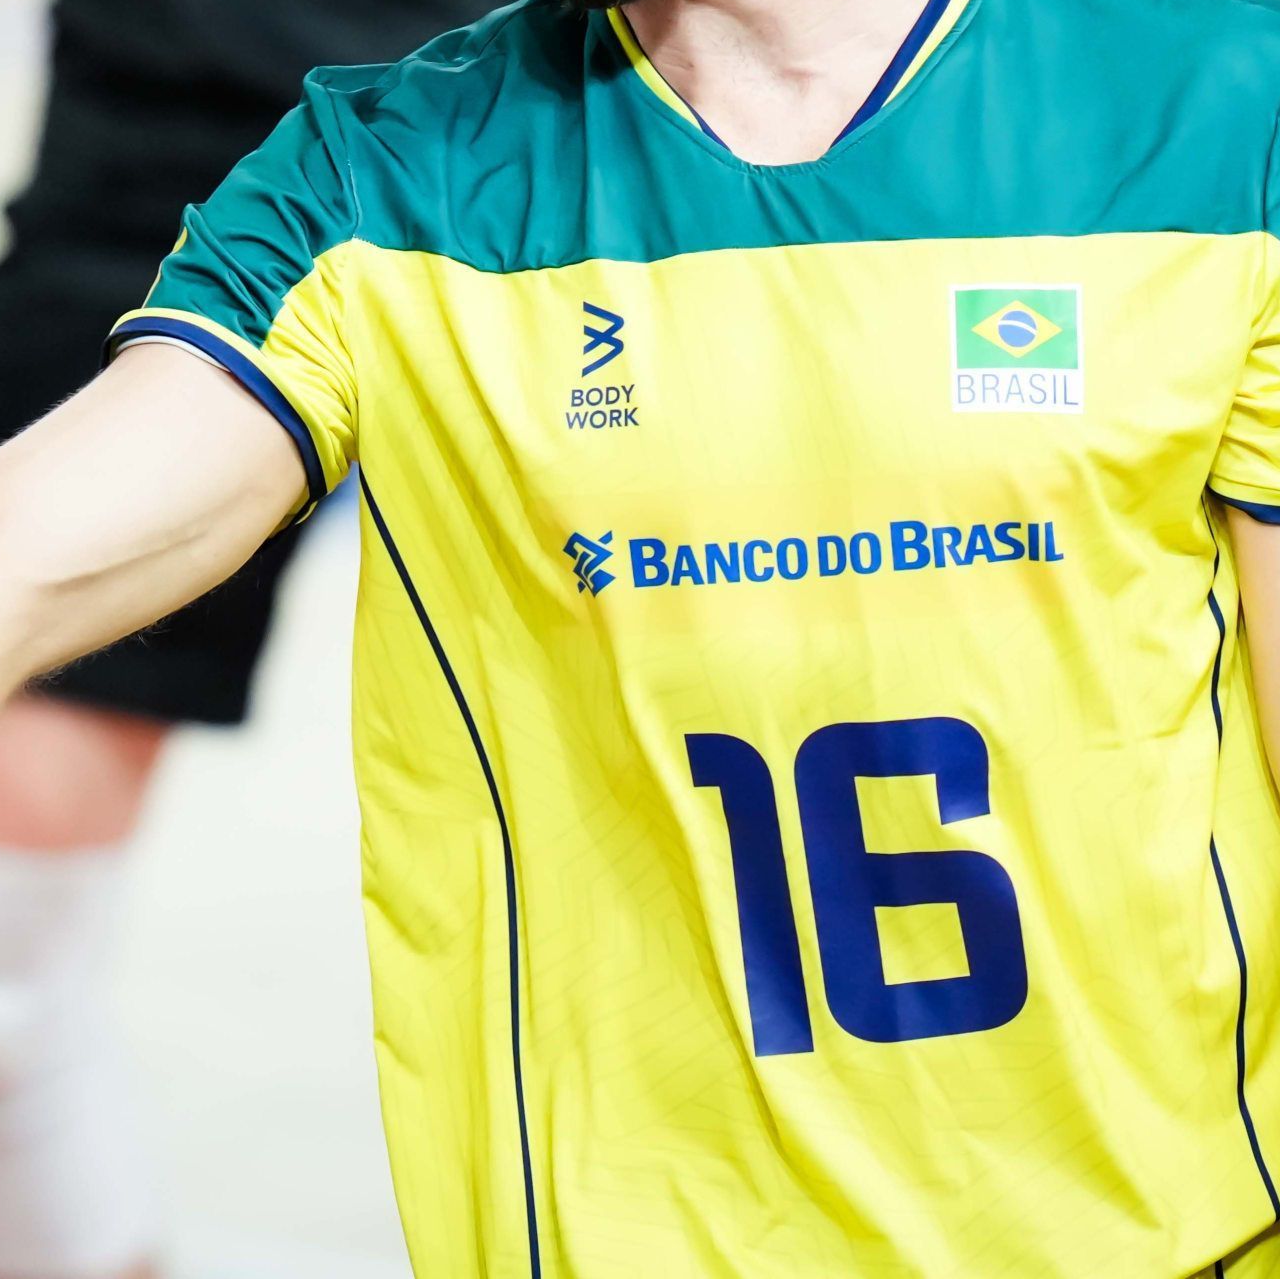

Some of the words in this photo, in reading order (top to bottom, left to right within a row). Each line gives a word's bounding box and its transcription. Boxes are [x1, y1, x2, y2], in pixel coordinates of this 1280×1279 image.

[570, 384, 635, 407] BODY
[956, 374, 1080, 407] BRASIL
[565, 409, 640, 430] WORK
[628, 537, 809, 588] BANCO
[819, 531, 882, 577] DO
[890, 520, 1065, 571] BRASIL
[684, 716, 1029, 1057] 16
